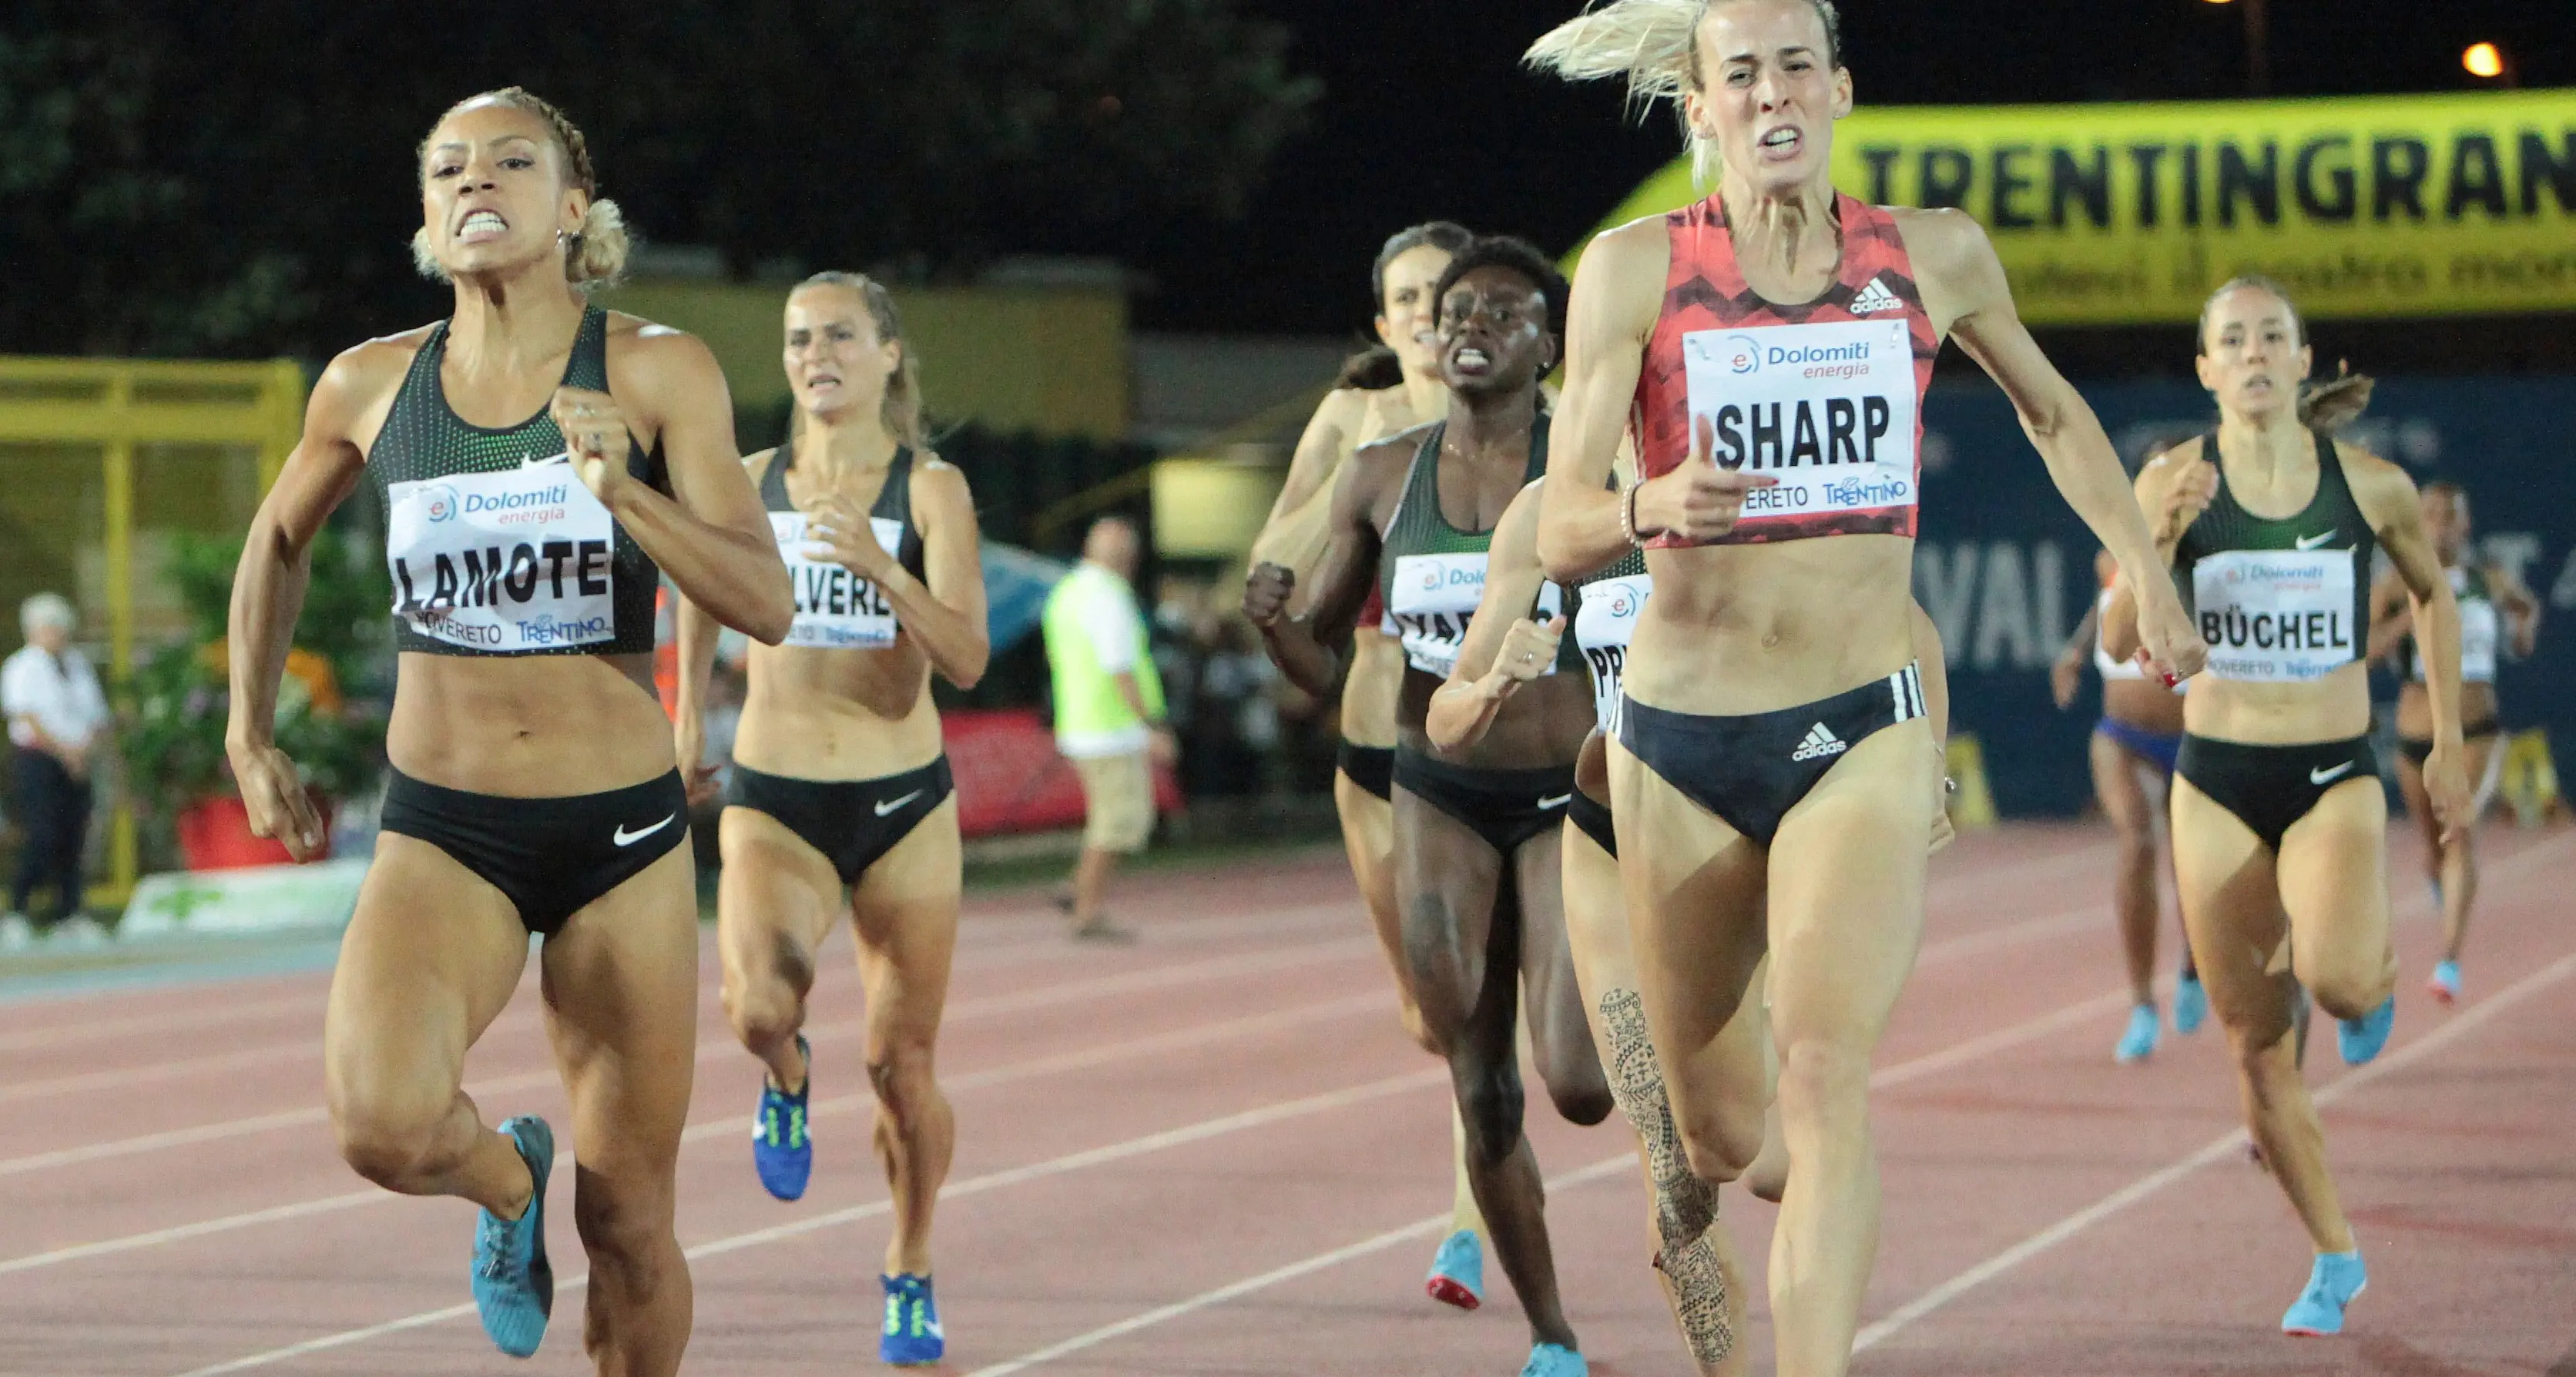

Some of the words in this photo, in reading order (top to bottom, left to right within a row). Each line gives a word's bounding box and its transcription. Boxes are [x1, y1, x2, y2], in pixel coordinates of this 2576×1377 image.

[1850, 297, 1903, 313] adidas
[1768, 342, 1870, 365] Dolomiti
[1803, 362, 1870, 380] energia
[1716, 395, 1890, 471] SHARP
[465, 484, 567, 513] Dolomiti
[1746, 485, 1809, 510] ERETO
[498, 506, 565, 524] energia
[395, 540, 607, 611] LAMOTE
[1921, 538, 2075, 668] VAL
[2200, 601, 2348, 649] BÜCHEL
[1792, 739, 1846, 762] adidas
